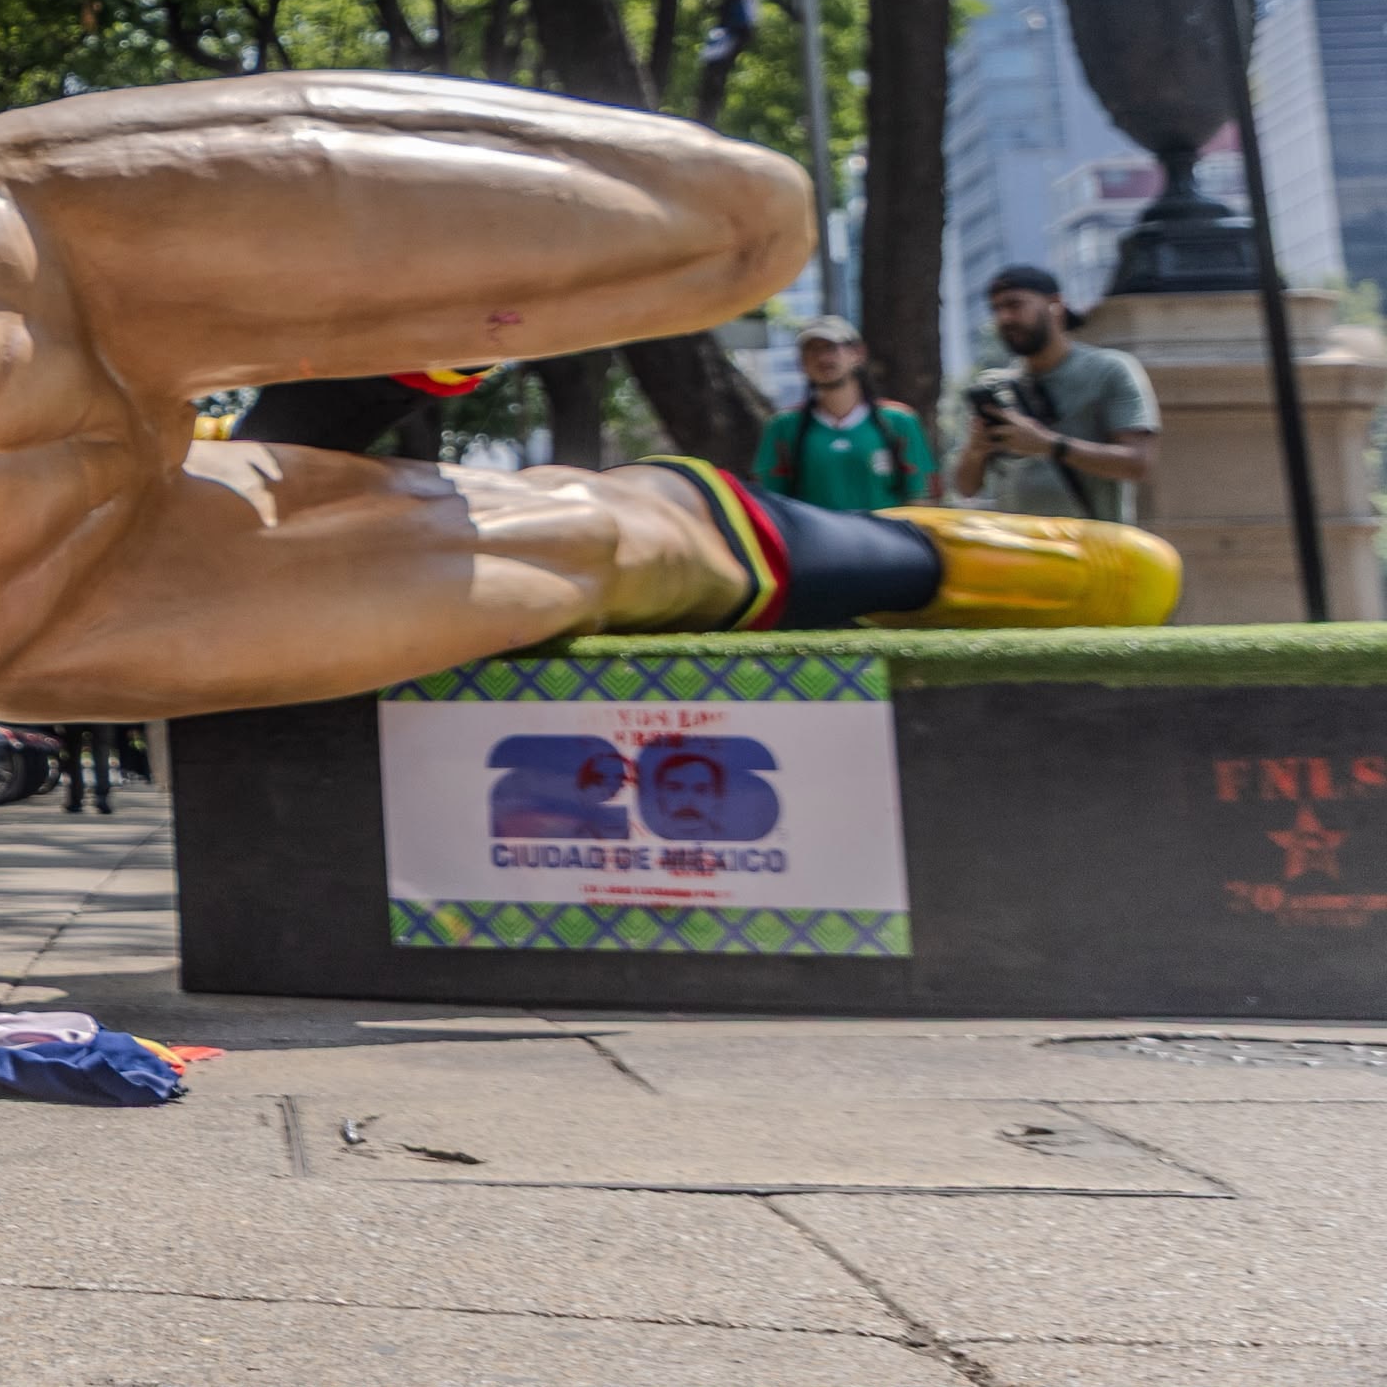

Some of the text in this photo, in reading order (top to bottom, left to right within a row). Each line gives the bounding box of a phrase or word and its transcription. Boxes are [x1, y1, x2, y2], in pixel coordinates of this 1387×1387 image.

[491, 841, 787, 874] CIUDAD DE MÉXICO
